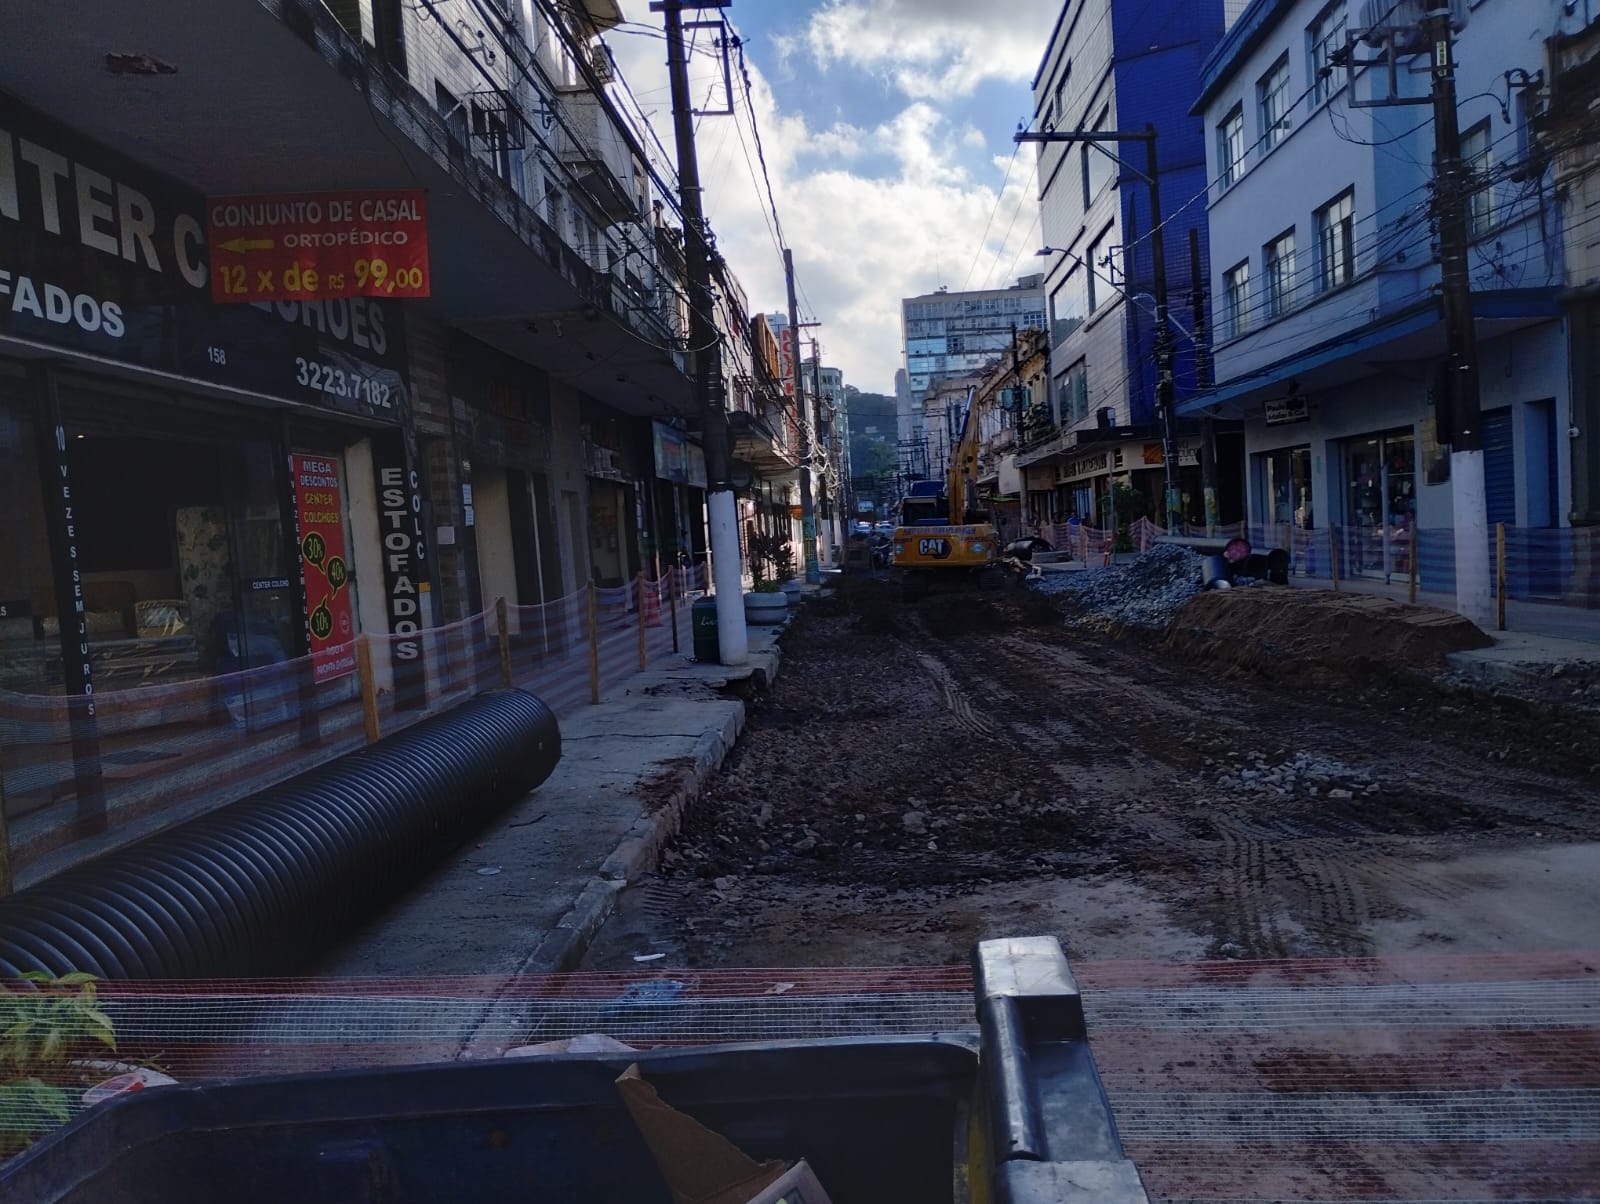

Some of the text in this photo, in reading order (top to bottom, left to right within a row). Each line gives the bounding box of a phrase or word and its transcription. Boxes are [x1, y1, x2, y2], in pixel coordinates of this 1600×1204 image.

[211, 199, 421, 228] CONJUNTO DE CASAL
[283, 227, 408, 248] ORTOPÉDICO
[219, 258, 423, 294] 12 x de R$ 99,00
[208, 345, 226, 365] 158
[303, 461, 332, 473] MEGA
[300, 475, 338, 488] DESCONTOS
[304, 492, 333, 505] CENTER
[919, 538, 944, 556] CAT
[381, 467, 419, 660] ESTOFADOS
[60, 464, 77, 558] VEZES
[73, 569, 85, 612] SEM
[79, 621, 95, 716] JUROS
